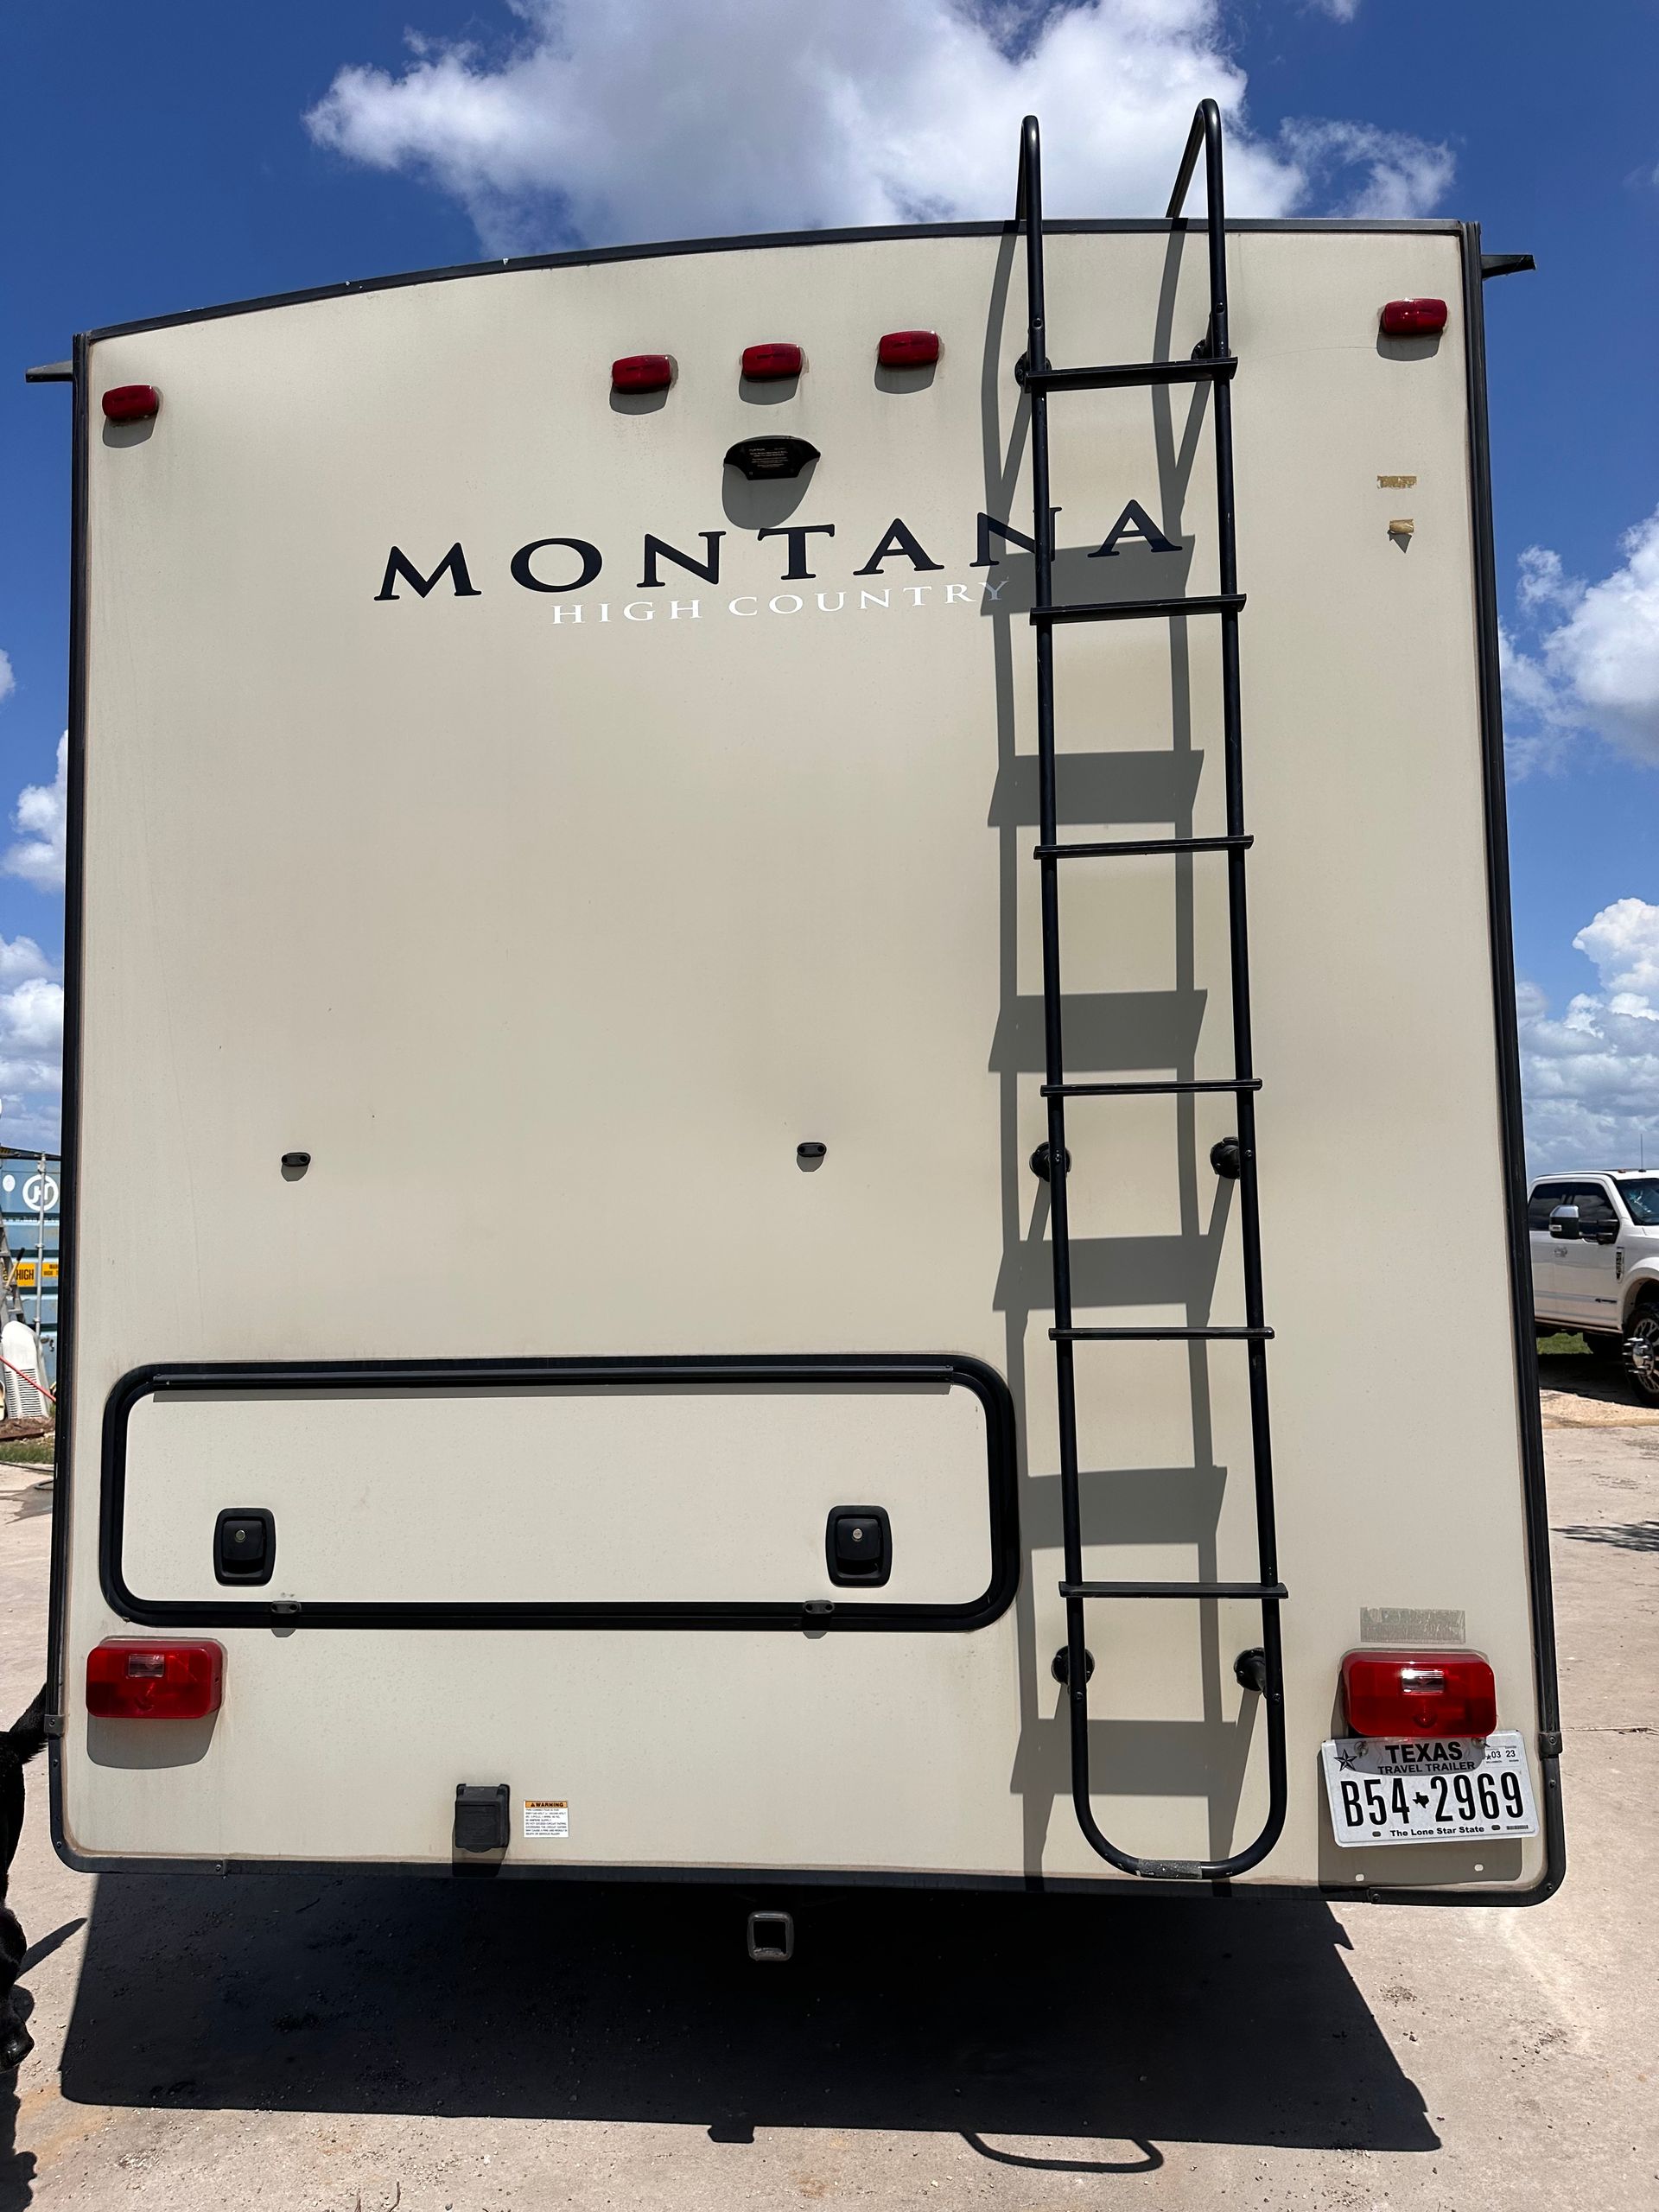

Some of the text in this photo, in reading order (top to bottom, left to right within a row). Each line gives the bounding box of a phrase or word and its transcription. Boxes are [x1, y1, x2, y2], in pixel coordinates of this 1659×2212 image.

[375, 499, 1183, 601] MONTANA
[551, 579, 1009, 626] HIGH COUNTRY
[1385, 1742, 1463, 1764] TEXAS
[1378, 1761, 1475, 1775] TRAVEL TRAILER
[1411, 1827, 1434, 1836] Lone
[1436, 1826, 1457, 1834] Star
[1459, 1824, 1484, 1833] State
